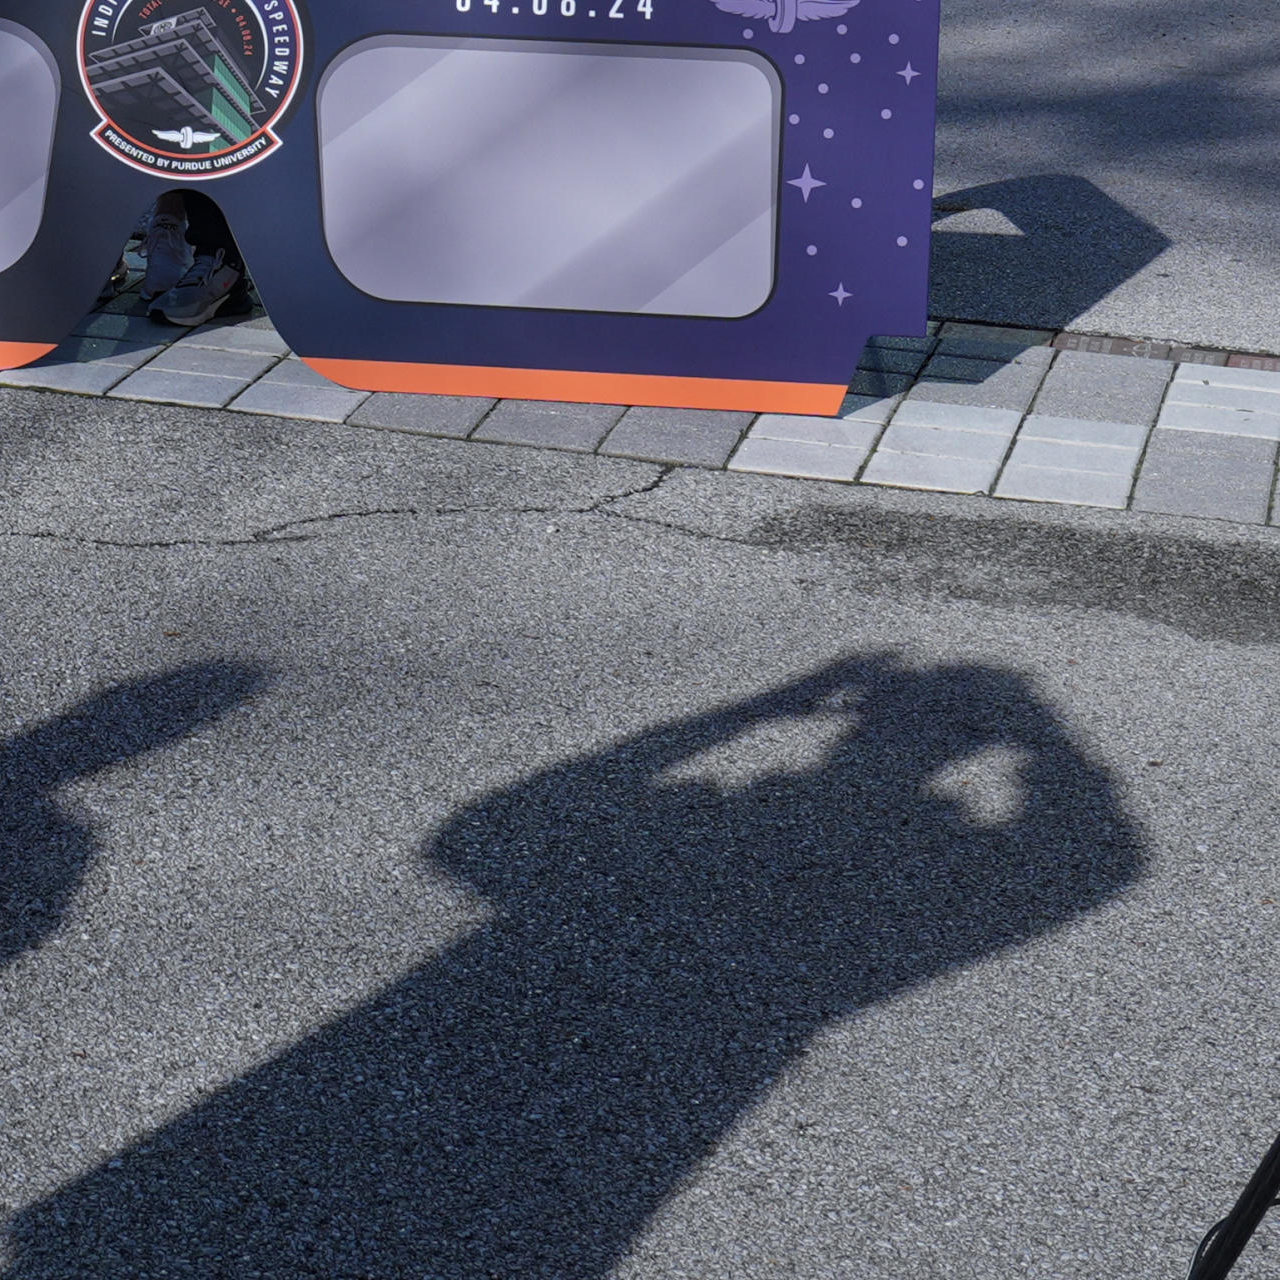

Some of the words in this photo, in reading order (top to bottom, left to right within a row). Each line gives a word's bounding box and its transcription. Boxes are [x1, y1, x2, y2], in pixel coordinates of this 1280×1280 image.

[264, 0, 290, 99] SPEEDWAY
[104, 129, 155, 164] PRESENTED
[156, 158, 170, 168] BY
[171, 160, 212, 171] PURDUE
[214, 136, 268, 168] UNIVERSITY
